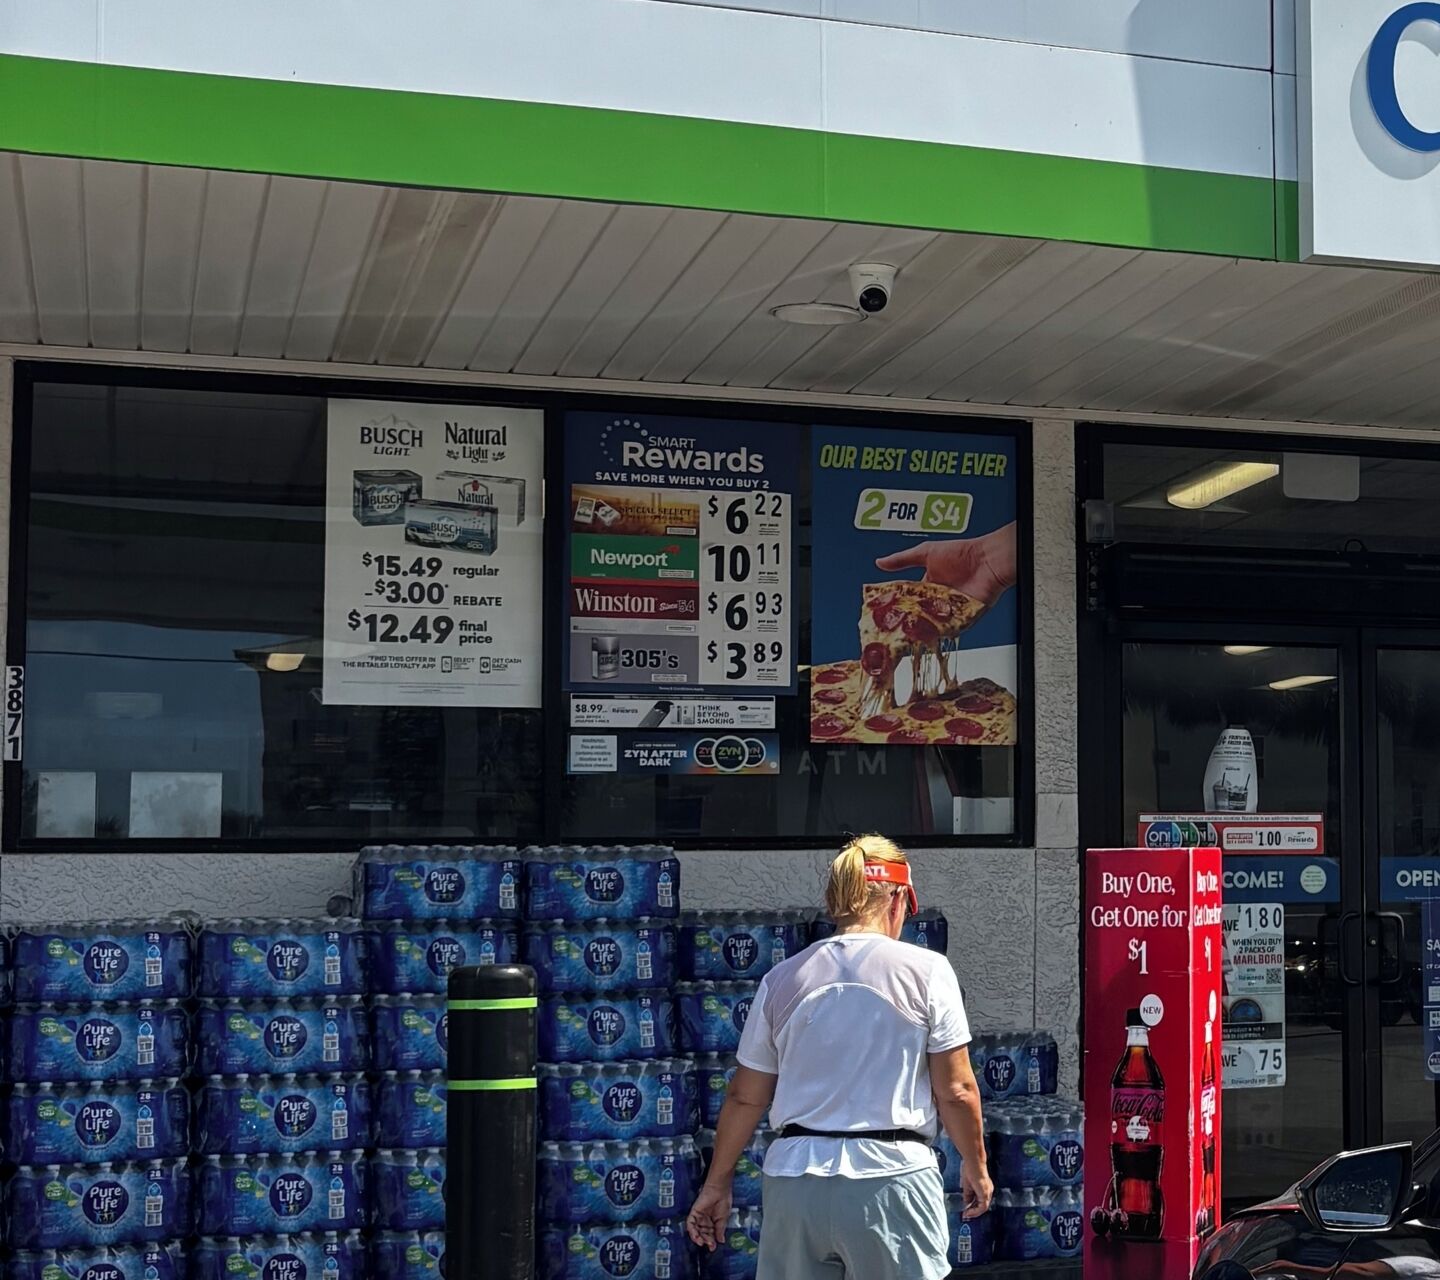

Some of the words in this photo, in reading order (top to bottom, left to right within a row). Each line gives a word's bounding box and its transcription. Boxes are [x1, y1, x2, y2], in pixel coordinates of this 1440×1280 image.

[360, 426, 423, 447] BUSCH
[445, 422, 507, 446] Natural
[649, 436, 696, 448] SMART
[373, 446, 410, 456] LIGHT
[462, 445, 489, 463] Light
[623, 441, 764, 473] Rewards
[819, 444, 857, 469] OUR
[860, 446, 907, 471] BEST
[909, 449, 958, 474] SLICE
[961, 452, 1008, 477] EVER
[595, 472, 627, 482] SAVE
[630, 473, 665, 483] MORE
[669, 475, 704, 486] WHEN
[708, 477, 734, 487] YOU
[736, 478, 760, 488] BUY
[762, 480, 769, 489] 2
[369, 494, 404, 505] BUSCH
[458, 489, 494, 505] Natural
[860, 491, 886, 527] 2
[887, 502, 918, 520] FOR
[928, 497, 960, 527] $4
[430, 522, 462, 533] BUSCH
[591, 548, 668, 568] Newport
[362, 551, 443, 577] $15.49
[453, 566, 500, 579] regular
[453, 596, 502, 606] REBATE
[575, 588, 656, 613] Winston
[347, 609, 454, 644] $12.49
[459, 620, 488, 632] final
[459, 634, 493, 646] price
[621, 649, 679, 669] 305's
[7, 667, 23, 760] 3871
[575, 704, 603, 713] $8.99
[697, 704, 721, 712] THINK
[697, 717, 735, 725] SMOKING
[624, 749, 648, 758] ZYN
[651, 749, 688, 758] AFTER
[718, 746, 742, 756] ZYN
[639, 758, 671, 767] DARK
[797, 750, 887, 775] ATM
[430, 872, 459, 882] Pure
[590, 870, 617, 881] Pure
[864, 865, 890, 877] ATL
[593, 880, 615, 891] Life
[1102, 872, 1134, 898] Buy
[1137, 871, 1176, 895] One,
[1222, 870, 1284, 889] COME!
[433, 881, 455, 893] Life
[1091, 905, 1122, 927] Get
[1123, 905, 1159, 927] One
[1161, 904, 1187, 927] for
[91, 946, 122, 958] Pure
[273, 944, 302, 956] Pure
[1128, 937, 1149, 975] $1
[93, 957, 118, 972] Life
[276, 955, 299, 970] Life
[1233, 954, 1283, 965] MARLBORO
[1142, 1006, 1161, 1015] NEW
[989, 1058, 1011, 1070] Pure
[991, 1070, 1010, 1082] Life
[86, 1270, 118, 1280] Pure
